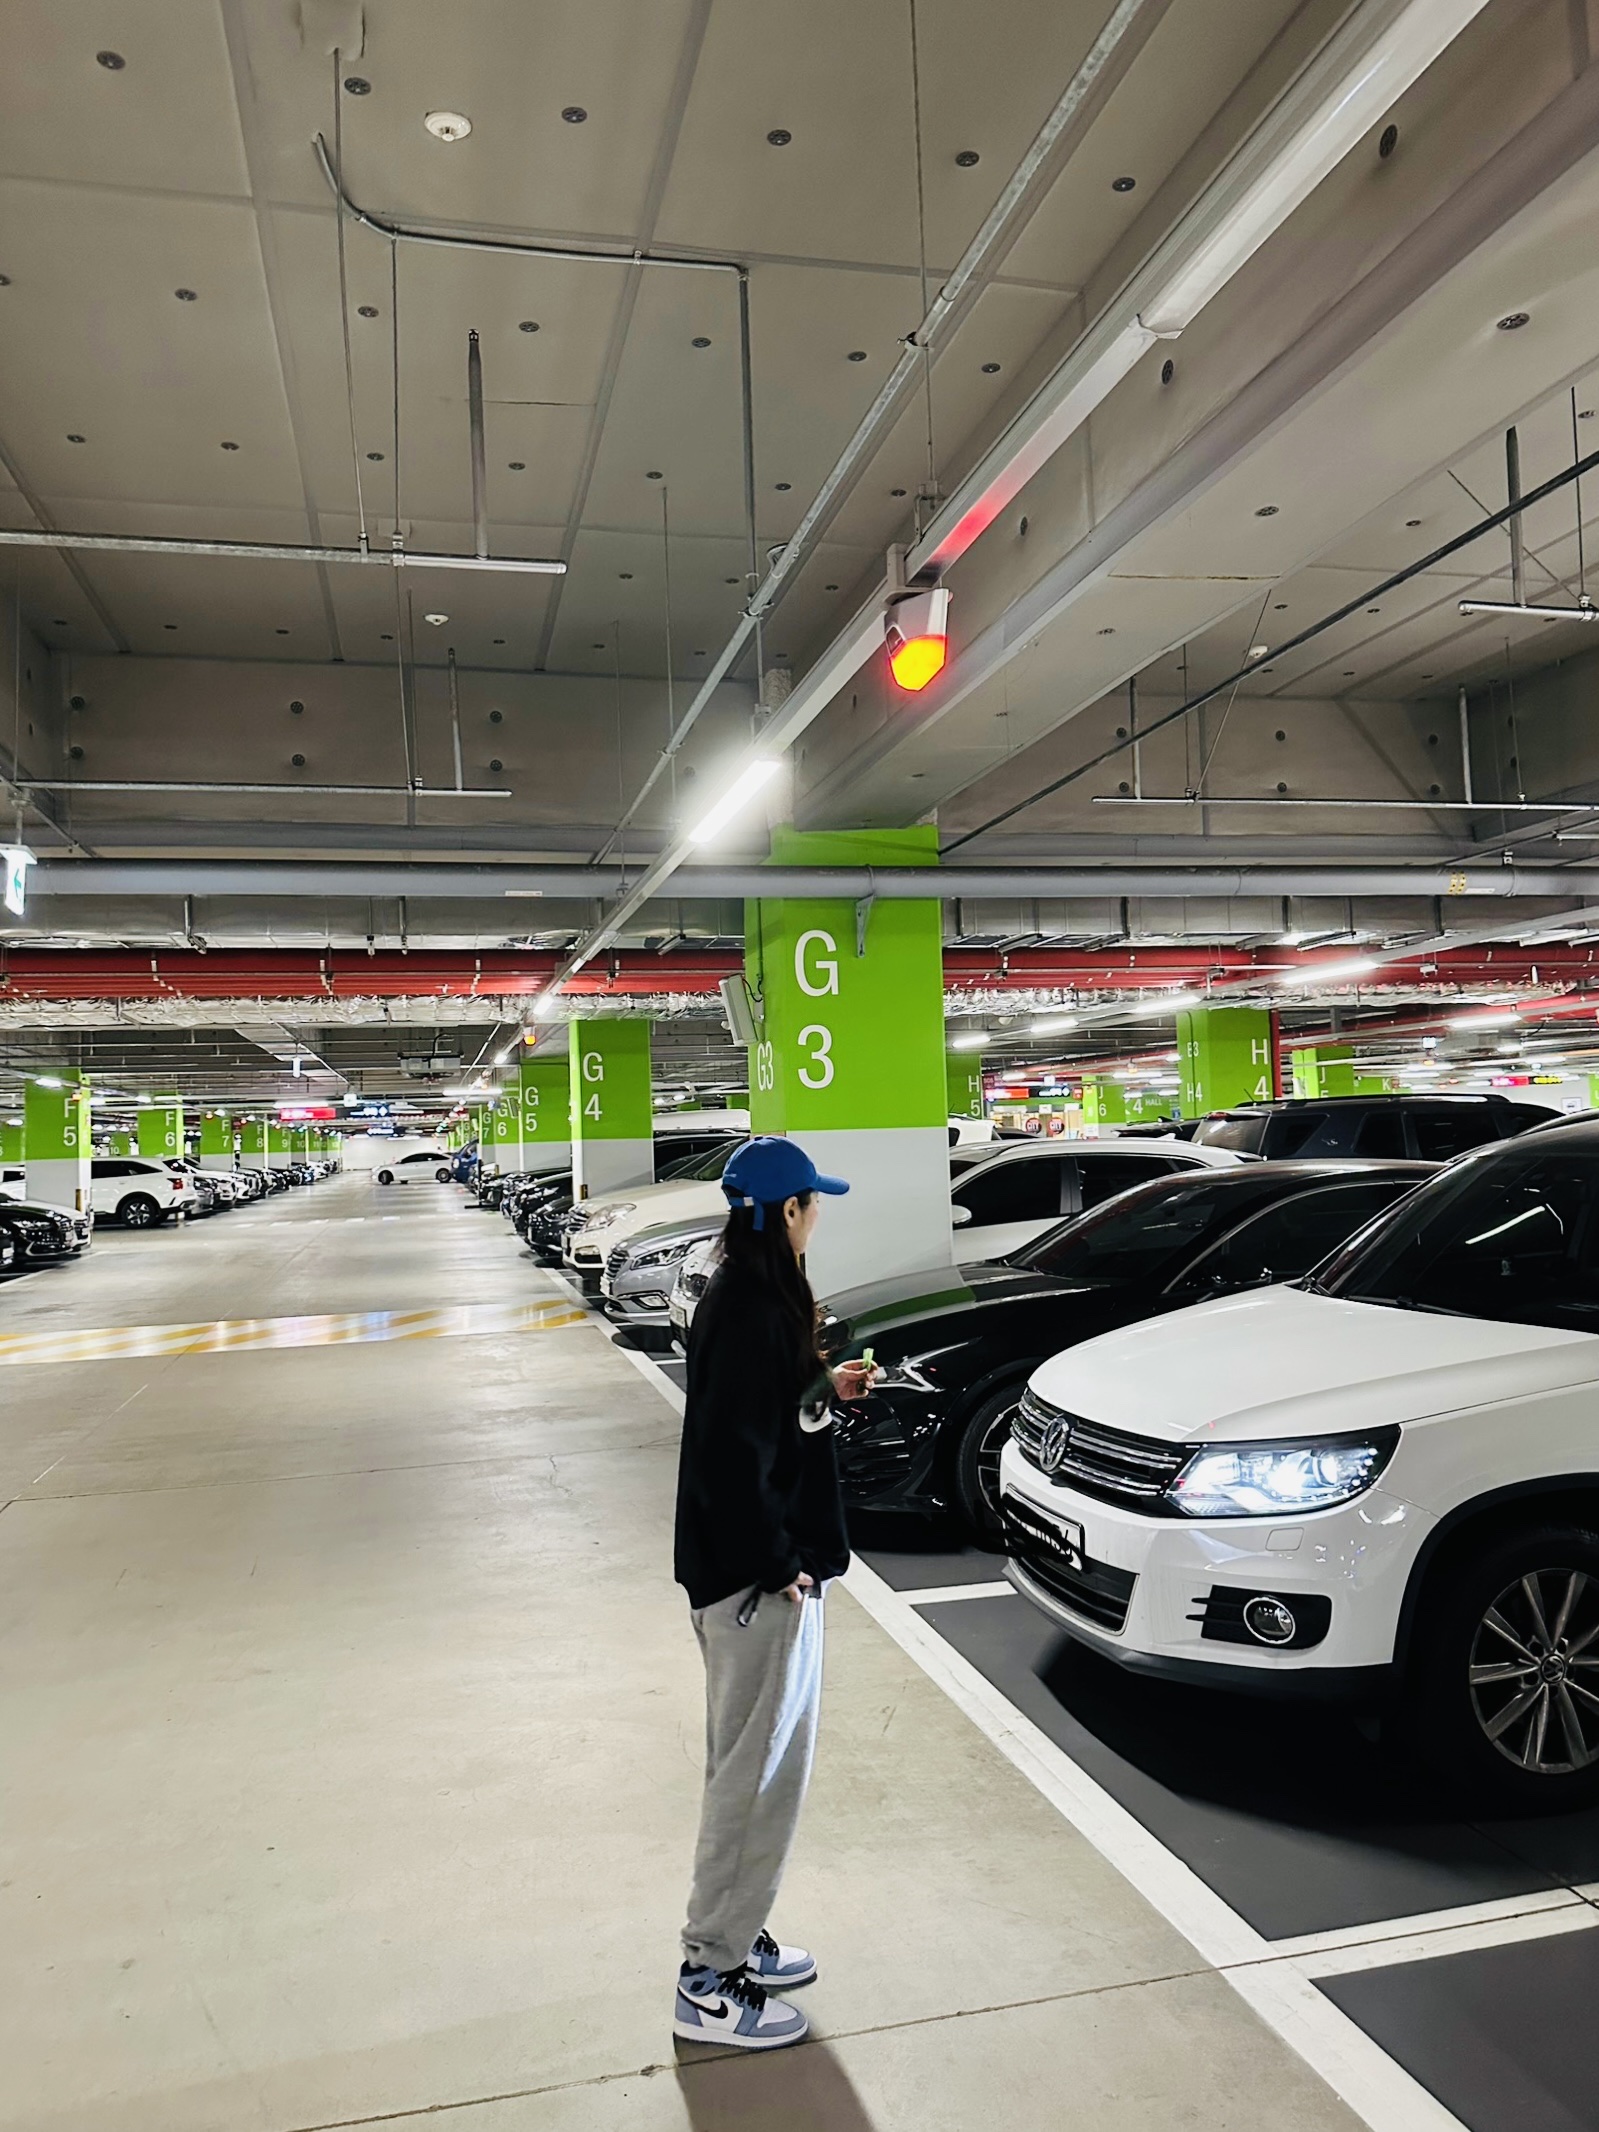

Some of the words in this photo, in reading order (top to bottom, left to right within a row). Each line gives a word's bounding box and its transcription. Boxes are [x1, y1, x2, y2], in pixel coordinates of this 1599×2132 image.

[795, 929, 839, 997] G
[797, 1024, 835, 1089] 3
[1251, 1038, 1268, 1065] H
[583, 1052, 604, 1082] G
[757, 1041, 774, 1091] G3
[968, 1075, 980, 1093] H
[1254, 1075, 1270, 1101] 4
[525, 1086, 540, 1106] G
[64, 1098, 77, 1118] F
[497, 1102, 508, 1118] G
[584, 1093, 603, 1121] 4
[970, 1099, 981, 1117] 5
[1098, 1103, 1107, 1117] 6
[165, 1111, 175, 1126] F
[497, 1121, 508, 1136] 6
[525, 1113, 538, 1132] 5
[63, 1126, 77, 1147] 5
[165, 1131, 176, 1147] 6
[221, 1136, 230, 1147] 7
